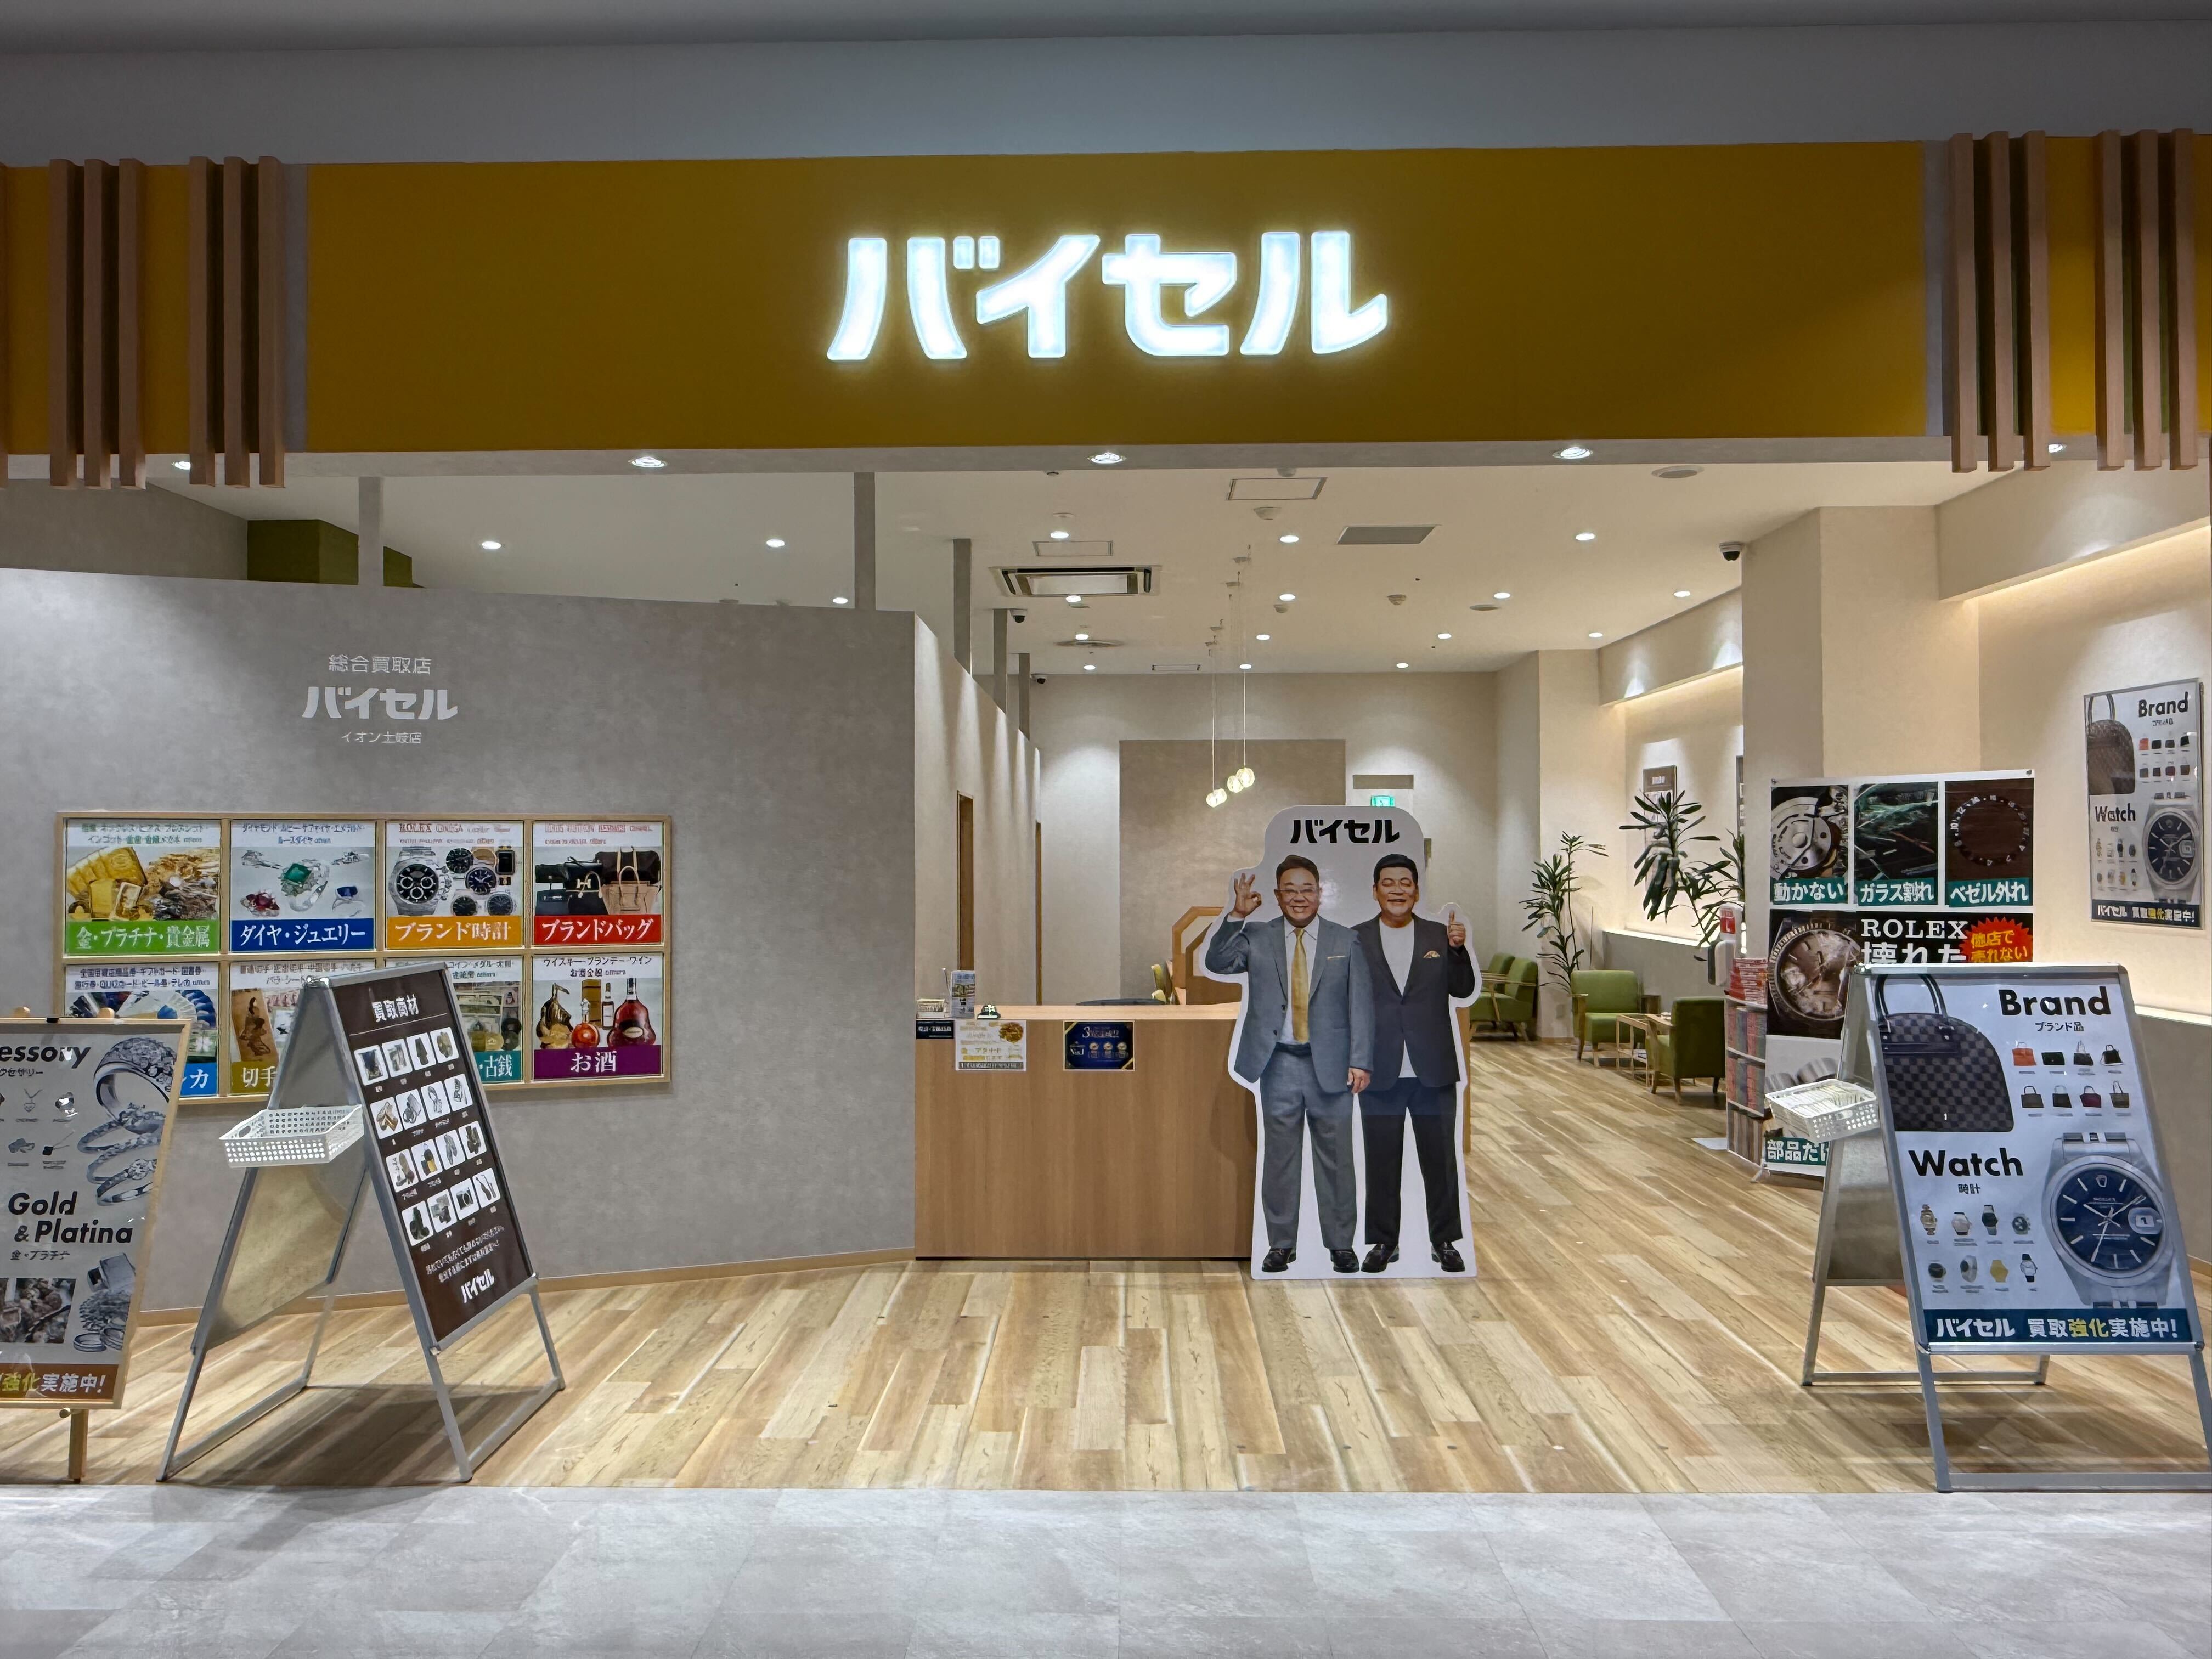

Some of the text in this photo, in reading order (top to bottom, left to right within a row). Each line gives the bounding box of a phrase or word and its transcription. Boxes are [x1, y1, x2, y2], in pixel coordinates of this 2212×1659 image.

[827, 231, 1387, 360] バイセル
[329, 654, 432, 675] 総合買取店
[302, 686, 458, 720] バイセル
[2138, 691, 2188, 718] Brand
[2095, 803, 2136, 822] Watch
[1290, 819, 1400, 844] バイセル
[1774, 882, 1843, 901] 動かない
[1860, 881, 1934, 903] ガラス割れ
[1950, 881, 2028, 903] ベゼル外れ
[76, 924, 210, 950] 金・プラチナ・貴金属
[240, 925, 366, 946] ダイヤ・ジュエリー
[395, 922, 511, 941] ブランド時計
[542, 918, 654, 941] ブランドバッグ
[1860, 919, 1968, 939] ROLEX
[1971, 930, 2015, 948] 他店で
[1998, 986, 2112, 1015] Brand
[2035, 1022, 2084, 1032] ブランド品
[571, 1051, 618, 1073] お酒
[182, 1069, 209, 1089] カ
[1908, 1148, 2024, 1176] Watch
[1958, 1184, 1981, 1194] 時計
[8, 1191, 78, 1215] Gold
[14, 1219, 133, 1243] & Platina
[461, 1268, 495, 1304] バイセル
[1937, 1318, 2016, 1338] バイセル
[0, 1372, 106, 1393] 強化実施中!
